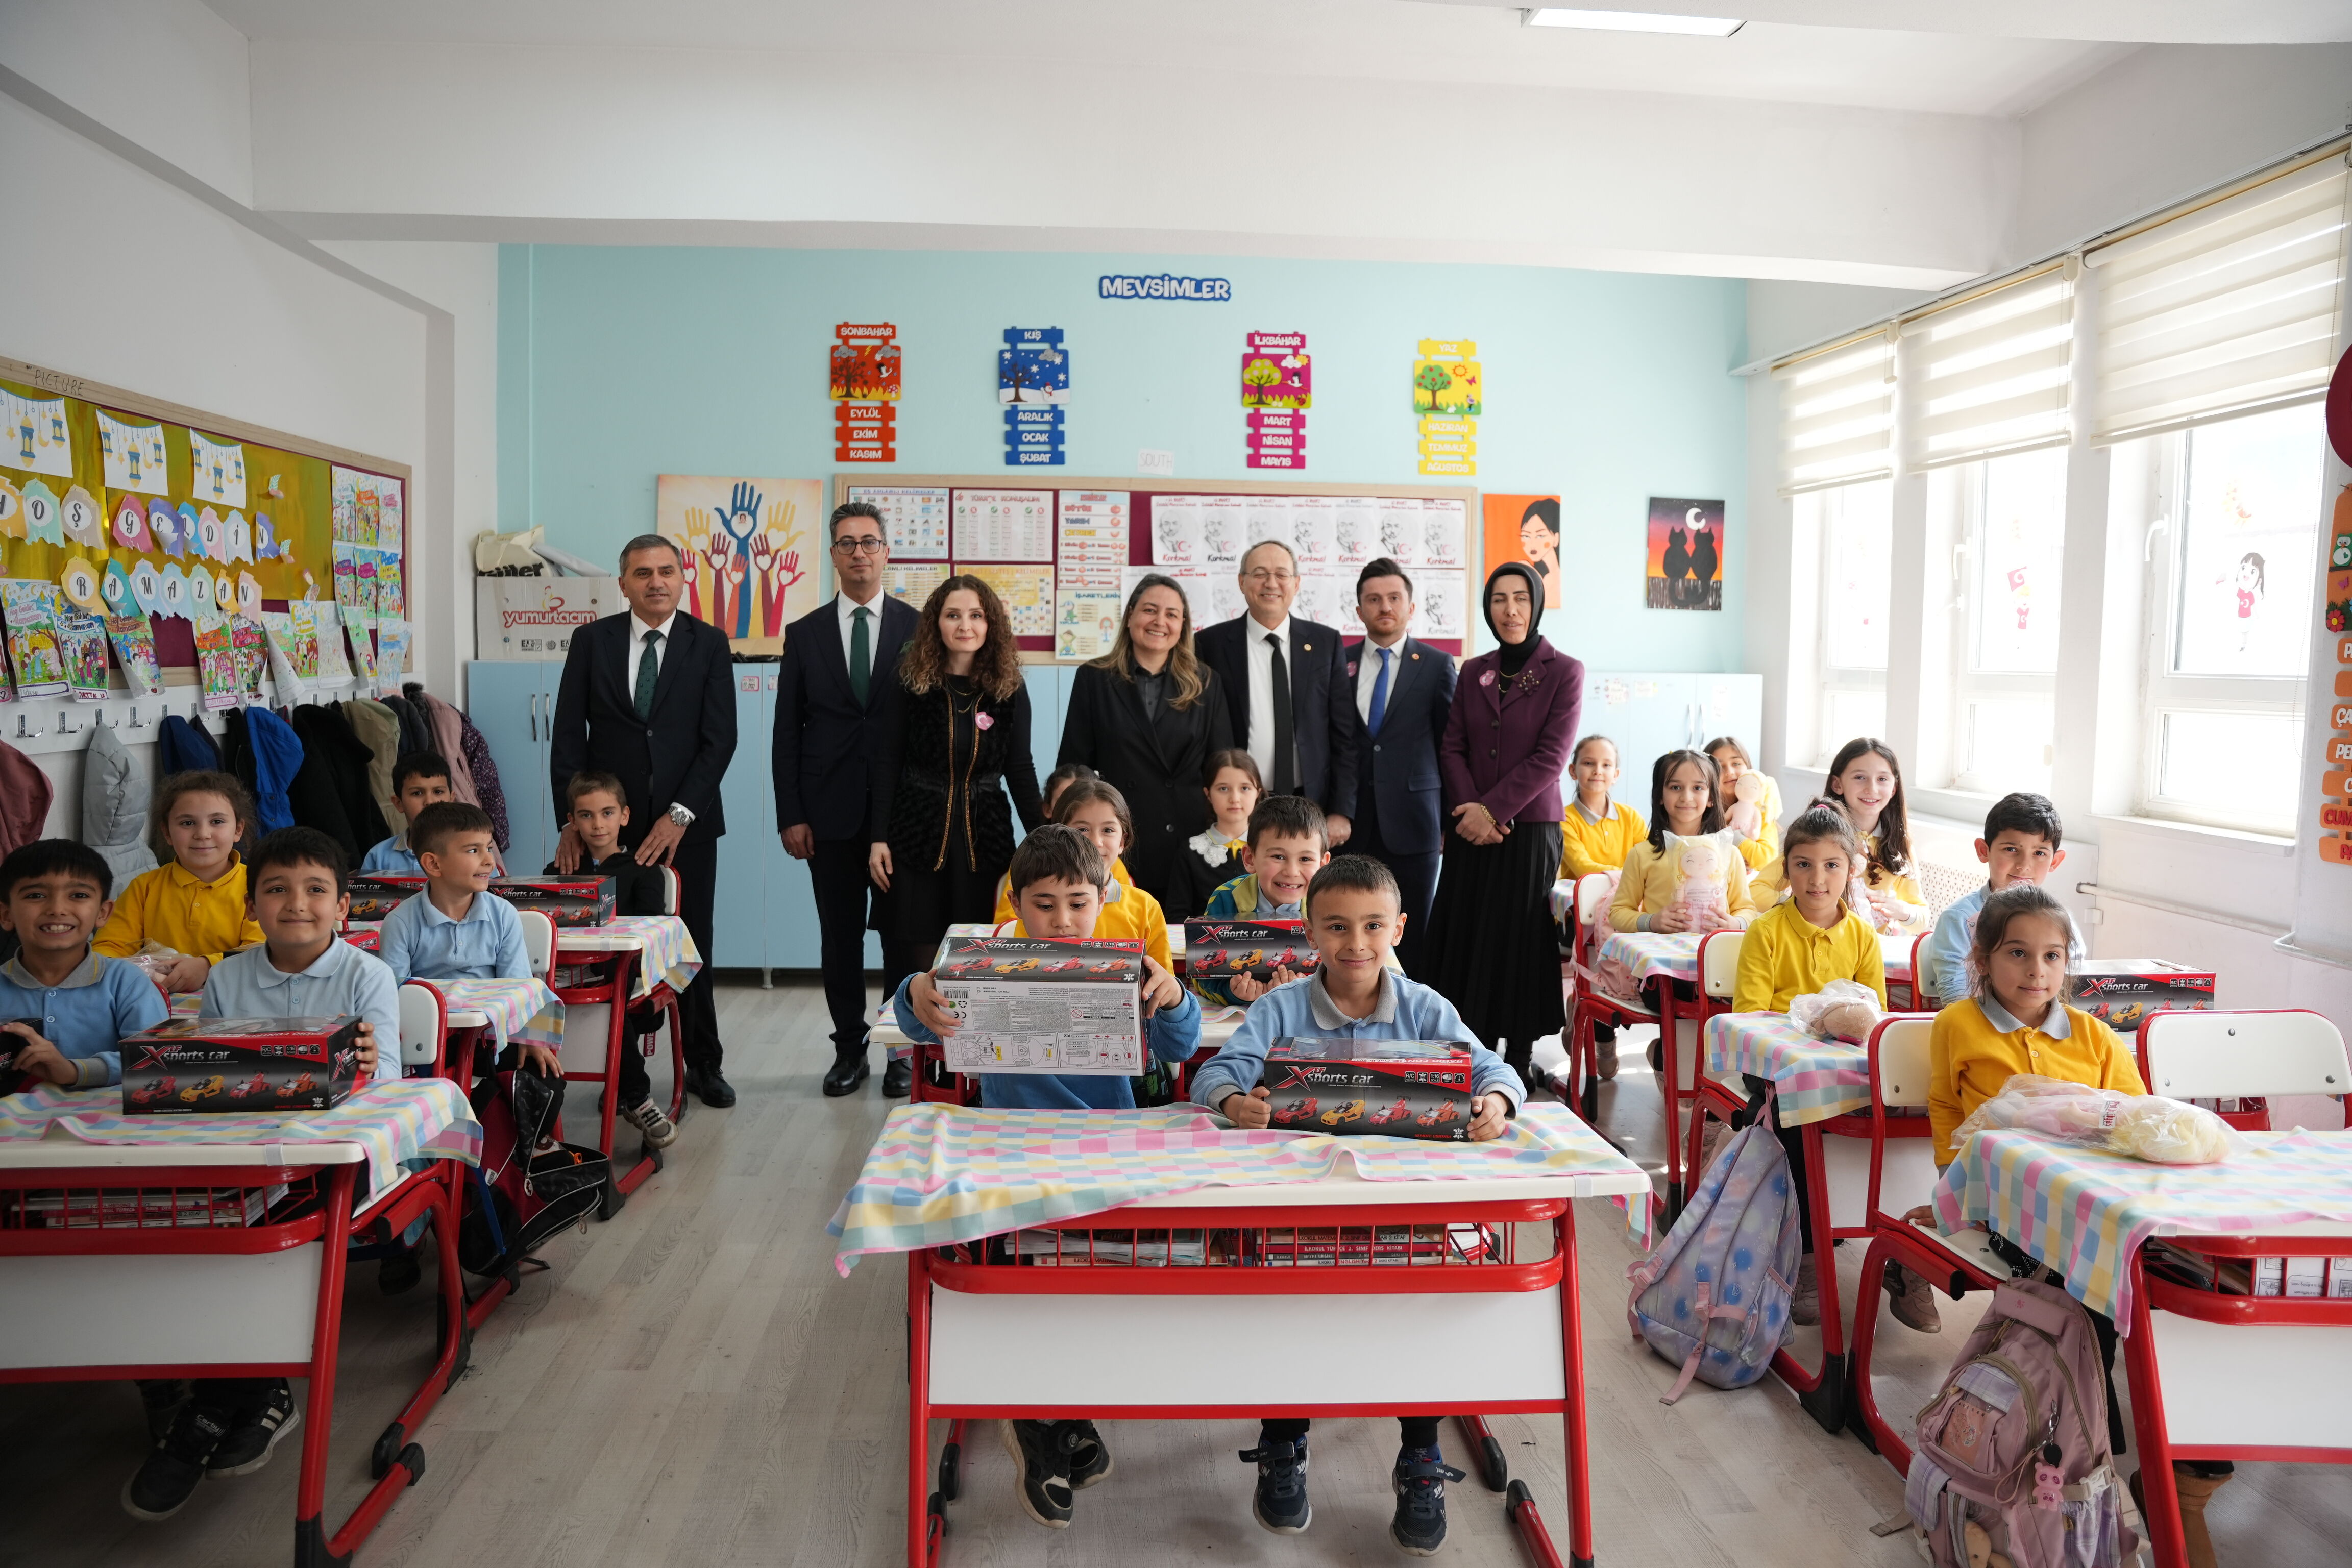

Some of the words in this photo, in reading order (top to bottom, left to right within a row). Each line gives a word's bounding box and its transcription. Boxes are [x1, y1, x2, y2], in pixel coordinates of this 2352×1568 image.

[1101, 275, 1230, 300] MEVSİMLER
[840, 327, 893, 337] SONBAHAR
[1024, 330, 1042, 340] KIŞ
[1254, 334, 1301, 346] İLKBAHAR
[1439, 344, 1458, 353] YAZ
[34, 369, 84, 397] PICTURE
[850, 407, 882, 419] EYLÜL
[1017, 412, 1054, 422] ARALIK
[1263, 416, 1292, 427] MART
[1427, 421, 1468, 433] HAZİRAN
[853, 429, 878, 439] EKİM
[1022, 432, 1049, 443] OCAK
[1262, 435, 1292, 447] NİSAN
[1427, 443, 1468, 453] TEMMUZ
[849, 450, 883, 459] KASIM
[1019, 453, 1051, 463] ŞUBAT
[1139, 454, 1173, 468] SOUTH
[1260, 456, 1292, 467] MAYIS
[76, 576, 249, 602] RAMAZAN
[15, 613, 42, 625] Ramazan
[503, 608, 597, 628] yumurtacım
[70, 621, 94, 631] Ramazan
[116, 623, 140, 633] Ramazan
[1218, 929, 1249, 941] sports
[1252, 930, 1268, 938] car
[2101, 983, 2130, 993] sports
[163, 1050, 205, 1061] sports
[208, 1051, 230, 1060] car
[1306, 1073, 1348, 1085] sports
[1352, 1075, 1374, 1084] car
